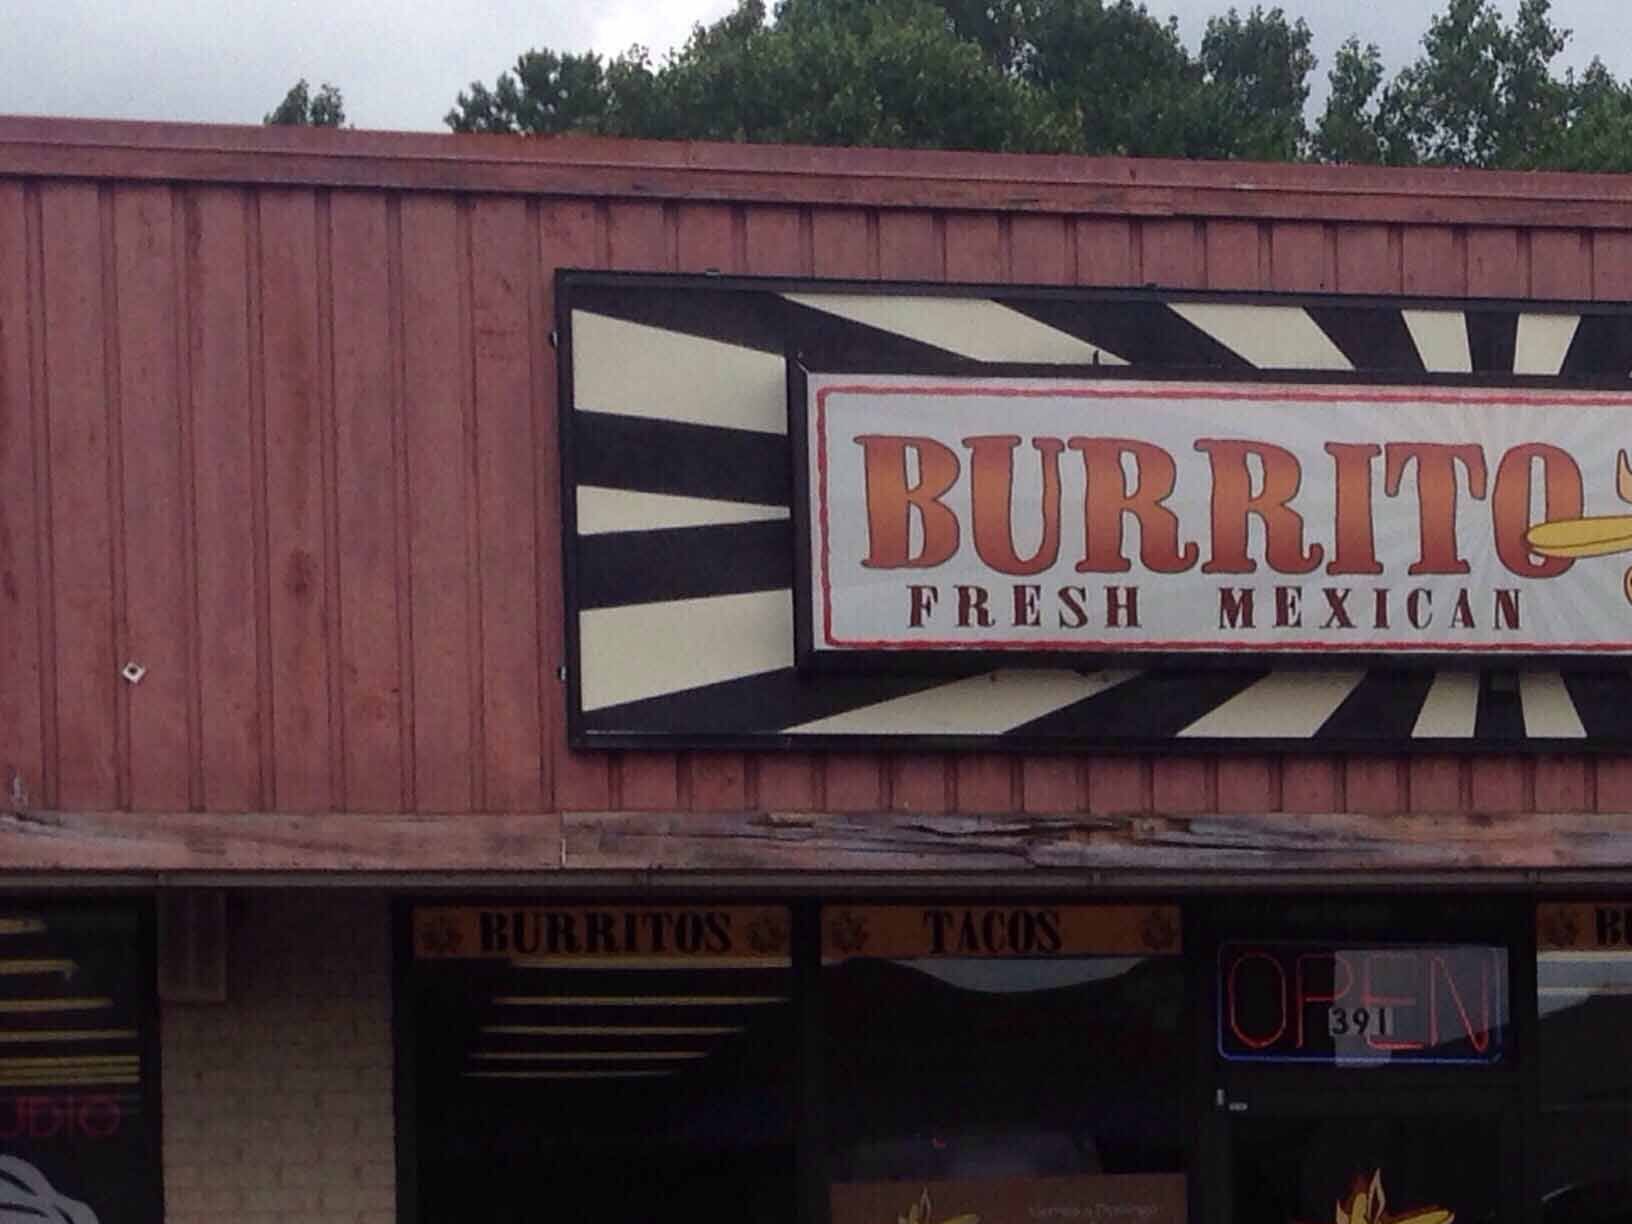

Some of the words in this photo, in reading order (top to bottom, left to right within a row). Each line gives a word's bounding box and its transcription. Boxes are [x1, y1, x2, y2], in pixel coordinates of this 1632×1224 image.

[852, 433, 1584, 579] BURRITO
[906, 584, 1143, 629] FRESH
[1218, 586, 1523, 631] MEXICAN
[479, 910, 733, 954] BURRITOS
[921, 909, 1063, 953] TACOS
[1226, 951, 1489, 1053] OPEN
[1330, 1005, 1389, 1035] 391
